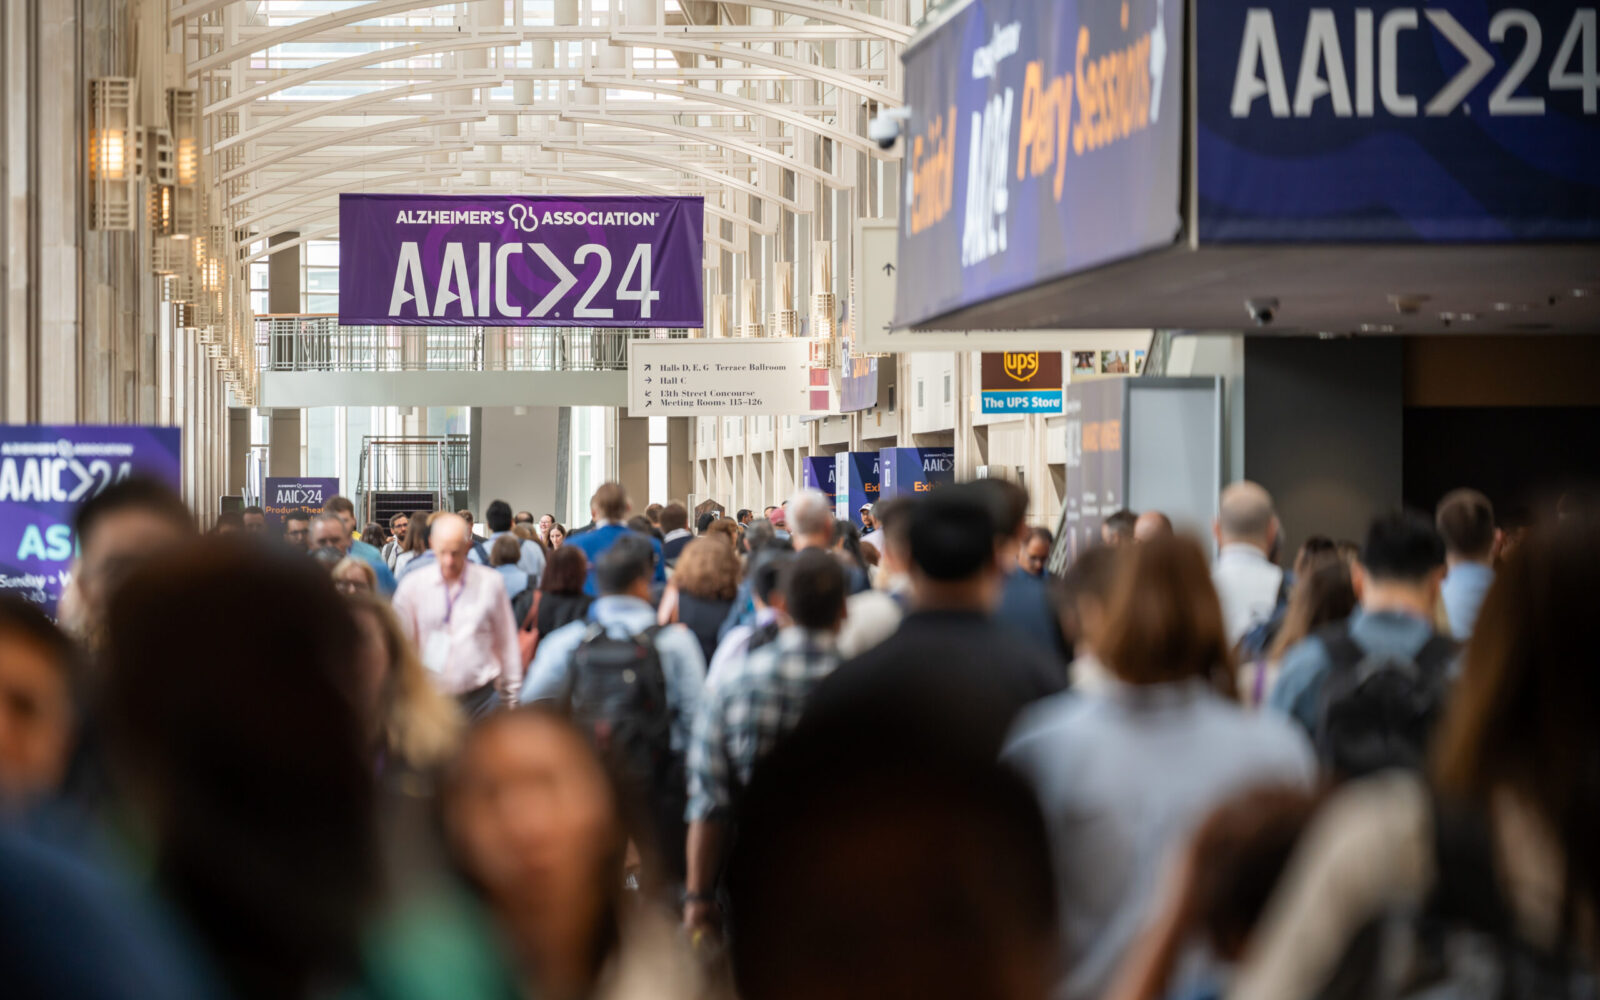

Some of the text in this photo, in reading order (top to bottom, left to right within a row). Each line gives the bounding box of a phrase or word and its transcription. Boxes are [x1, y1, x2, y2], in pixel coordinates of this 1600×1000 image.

[396, 210, 504, 225] ALZHEIMER'S
[660, 364, 680, 372] Halls
[749, 363, 786, 371] Ballroom
[1007, 353, 1036, 375] ups
[660, 399, 694, 407] Meeting
[984, 397, 1004, 408] The
[1007, 397, 1029, 408] UPS
[1031, 396, 1060, 408] Store
